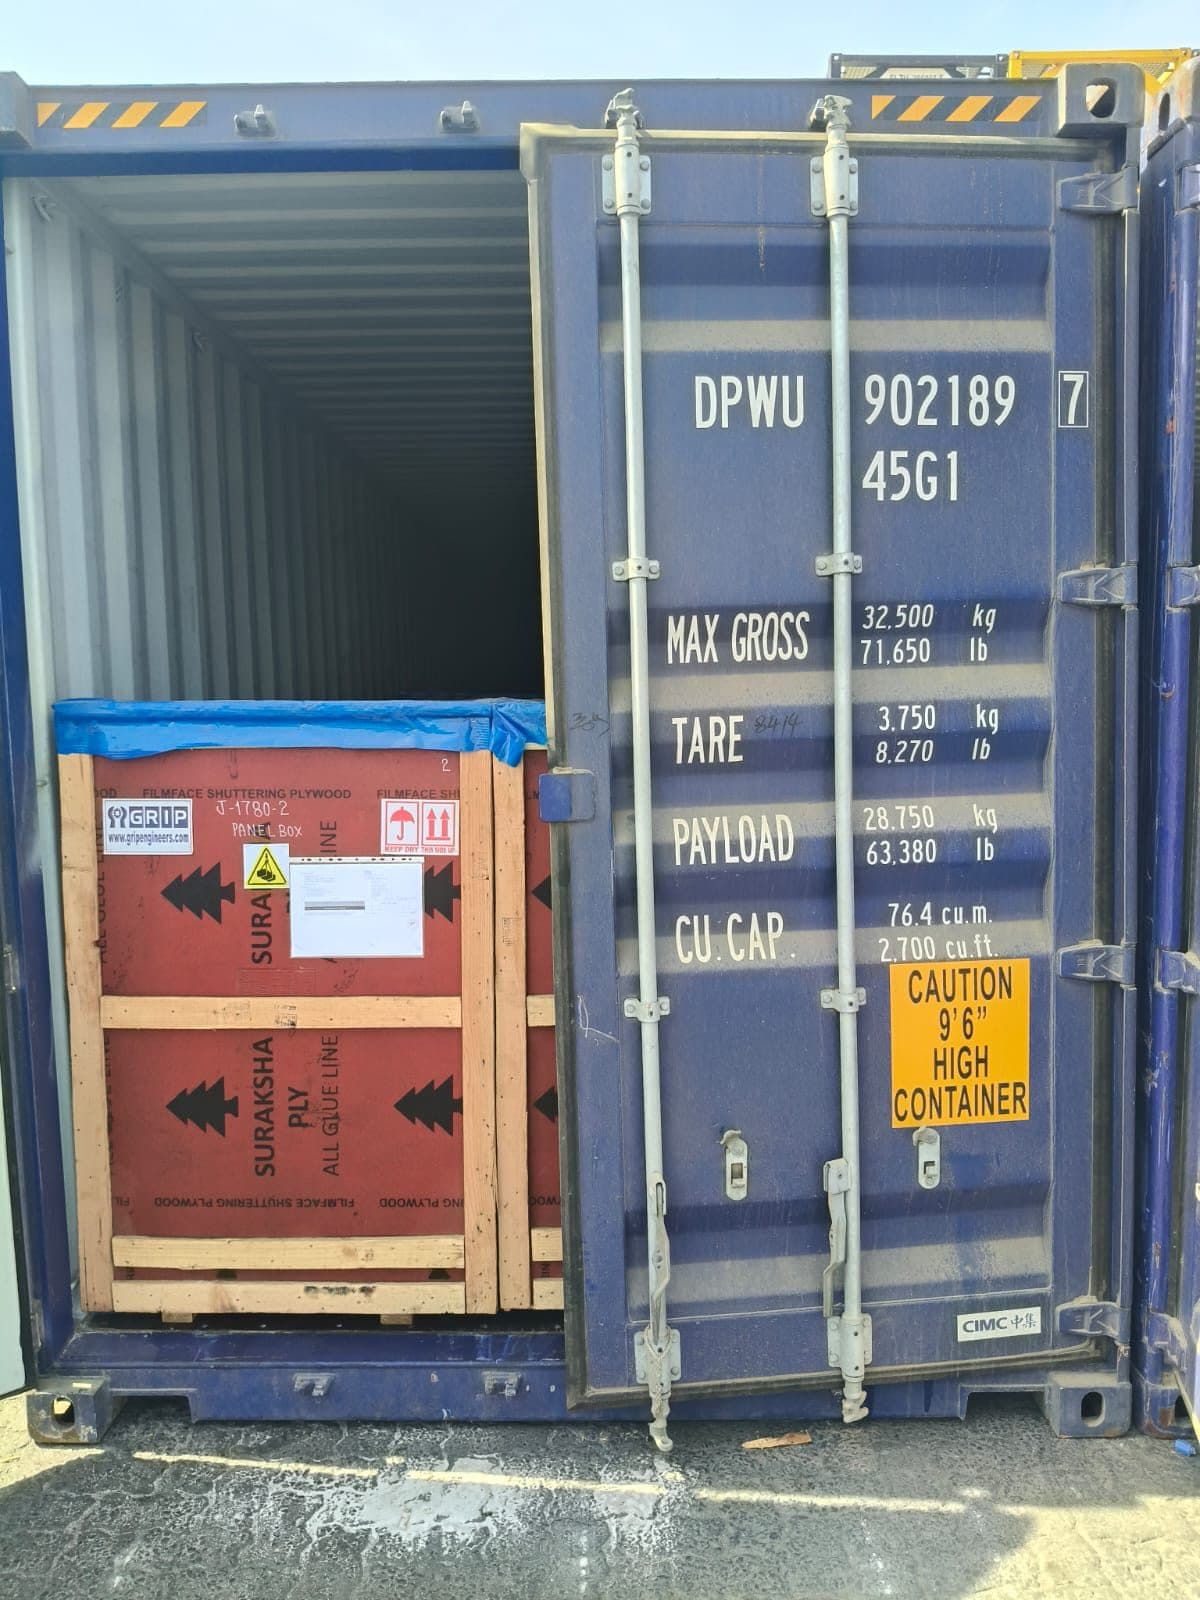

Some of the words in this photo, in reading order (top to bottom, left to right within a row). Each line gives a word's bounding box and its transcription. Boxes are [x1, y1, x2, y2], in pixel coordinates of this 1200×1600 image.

[694, 375, 805, 428] DPWU
[864, 374, 1016, 426] 9021189
[1063, 375, 1085, 425] 7
[862, 450, 959, 501] 45G1
[972, 603, 997, 634] kg
[667, 613, 720, 665] MAX
[731, 611, 809, 663] GROSS
[970, 637, 988, 662] lb
[976, 703, 999, 735] kg
[671, 714, 744, 765] TARE
[971, 738, 991, 761] lb
[441, 758, 452, 772] 2
[142, 788, 203, 799] FILMFACE
[207, 788, 287, 799] SHUTTERING
[289, 788, 352, 799] PLYWOOD
[376, 788, 436, 799] FILMFACE
[130, 806, 188, 828] GRIP
[231, 822, 276, 839] PANEL
[278, 824, 303, 838] BOX
[972, 803, 998, 834] kg
[108, 831, 188, 845] www.gripengineers.com
[320, 821, 337, 857] INE
[673, 814, 795, 866] PAYLOAD
[976, 837, 995, 861] lb
[888, 901, 932, 927] 76.4
[908, 966, 1012, 1004] CAUTION
[321, 1035, 339, 1078] LINE
[933, 1045, 988, 1081] HIGH
[252, 1036, 276, 1177] SURAKSHA
[287, 1086, 309, 1129] PLY
[321, 1086, 340, 1137] GLUE
[894, 1081, 1027, 1122] CONTAINER
[322, 1143, 340, 1177] ALL
[154, 1196, 212, 1208] PLYWOOD
[216, 1197, 292, 1208] SHUTTERING
[296, 1197, 354, 1208] FILMFACE
[379, 1197, 439, 1208] PLYWOOD
[962, 1316, 1008, 1333] CIMC
[1010, 1311, 1037, 1330] 中集
